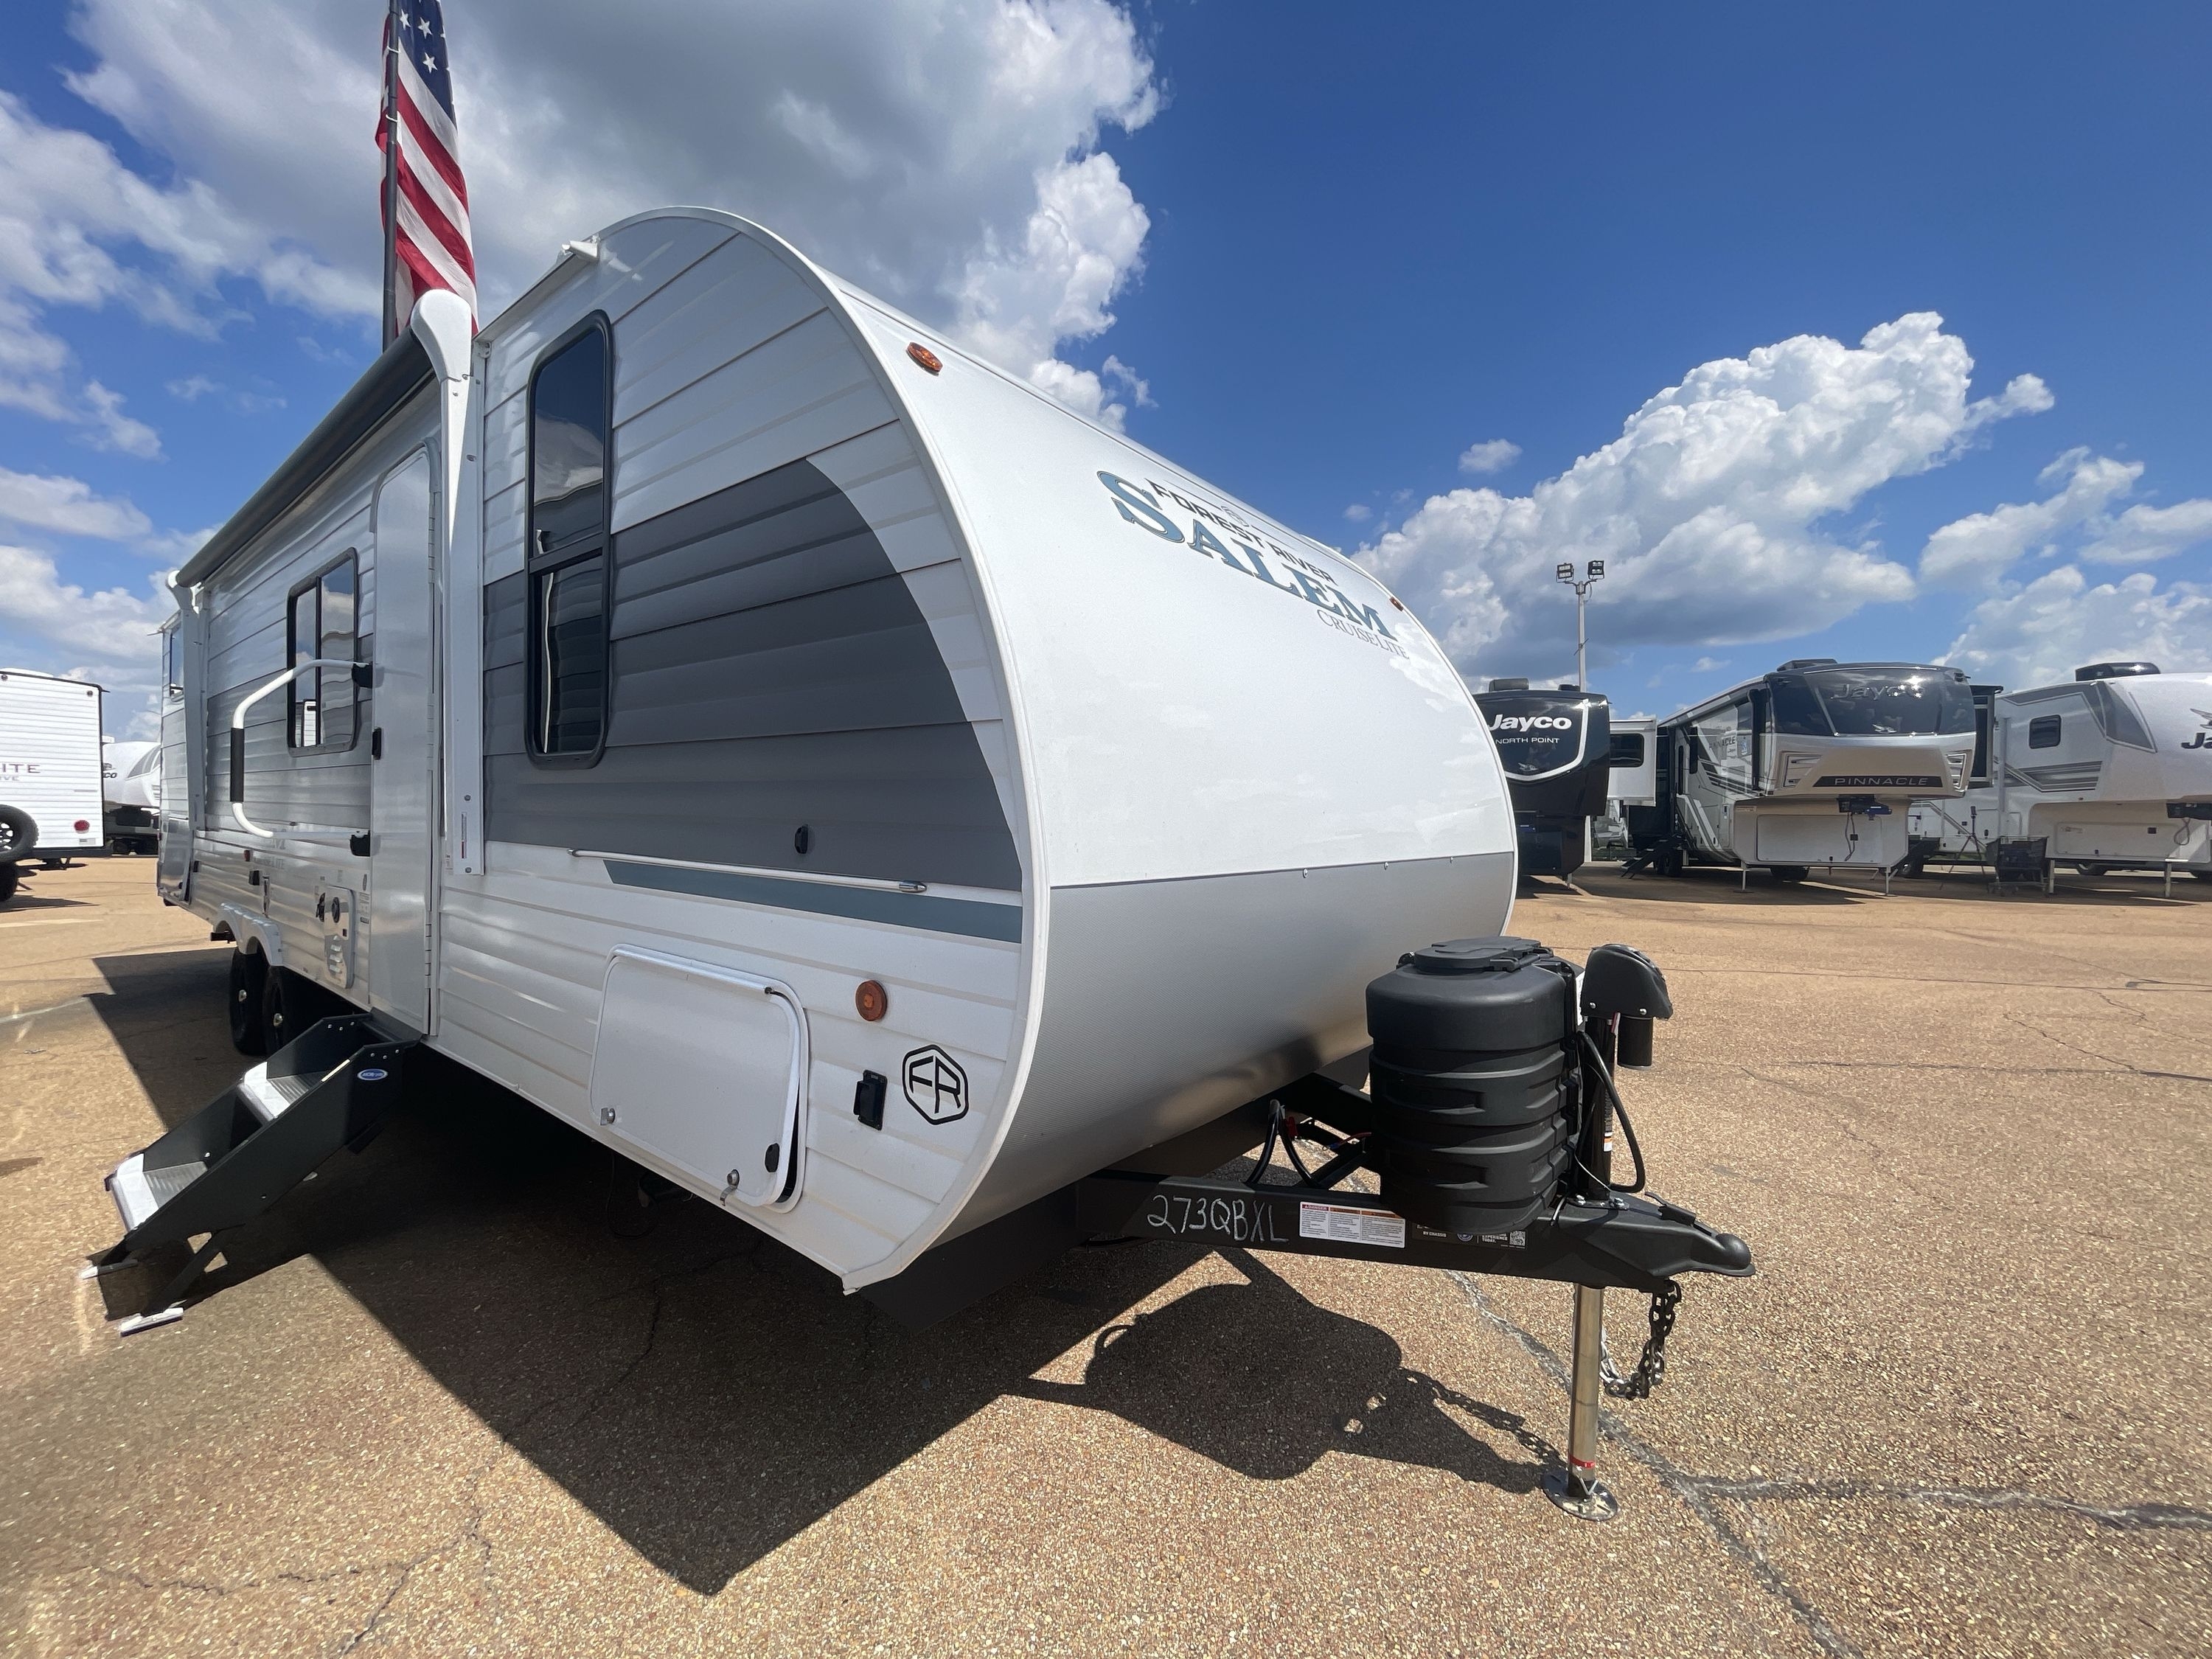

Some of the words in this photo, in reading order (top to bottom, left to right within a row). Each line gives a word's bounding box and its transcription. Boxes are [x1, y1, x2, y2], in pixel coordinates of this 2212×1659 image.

[1096, 470, 1399, 642] SALEM
[1144, 478, 1265, 549] FOREST
[1265, 540, 1339, 586] RIVER
[1488, 714, 1572, 732] Jayco
[1834, 777, 1929, 786] PINNACLE
[1147, 1194, 1290, 1242] 273QBXL
